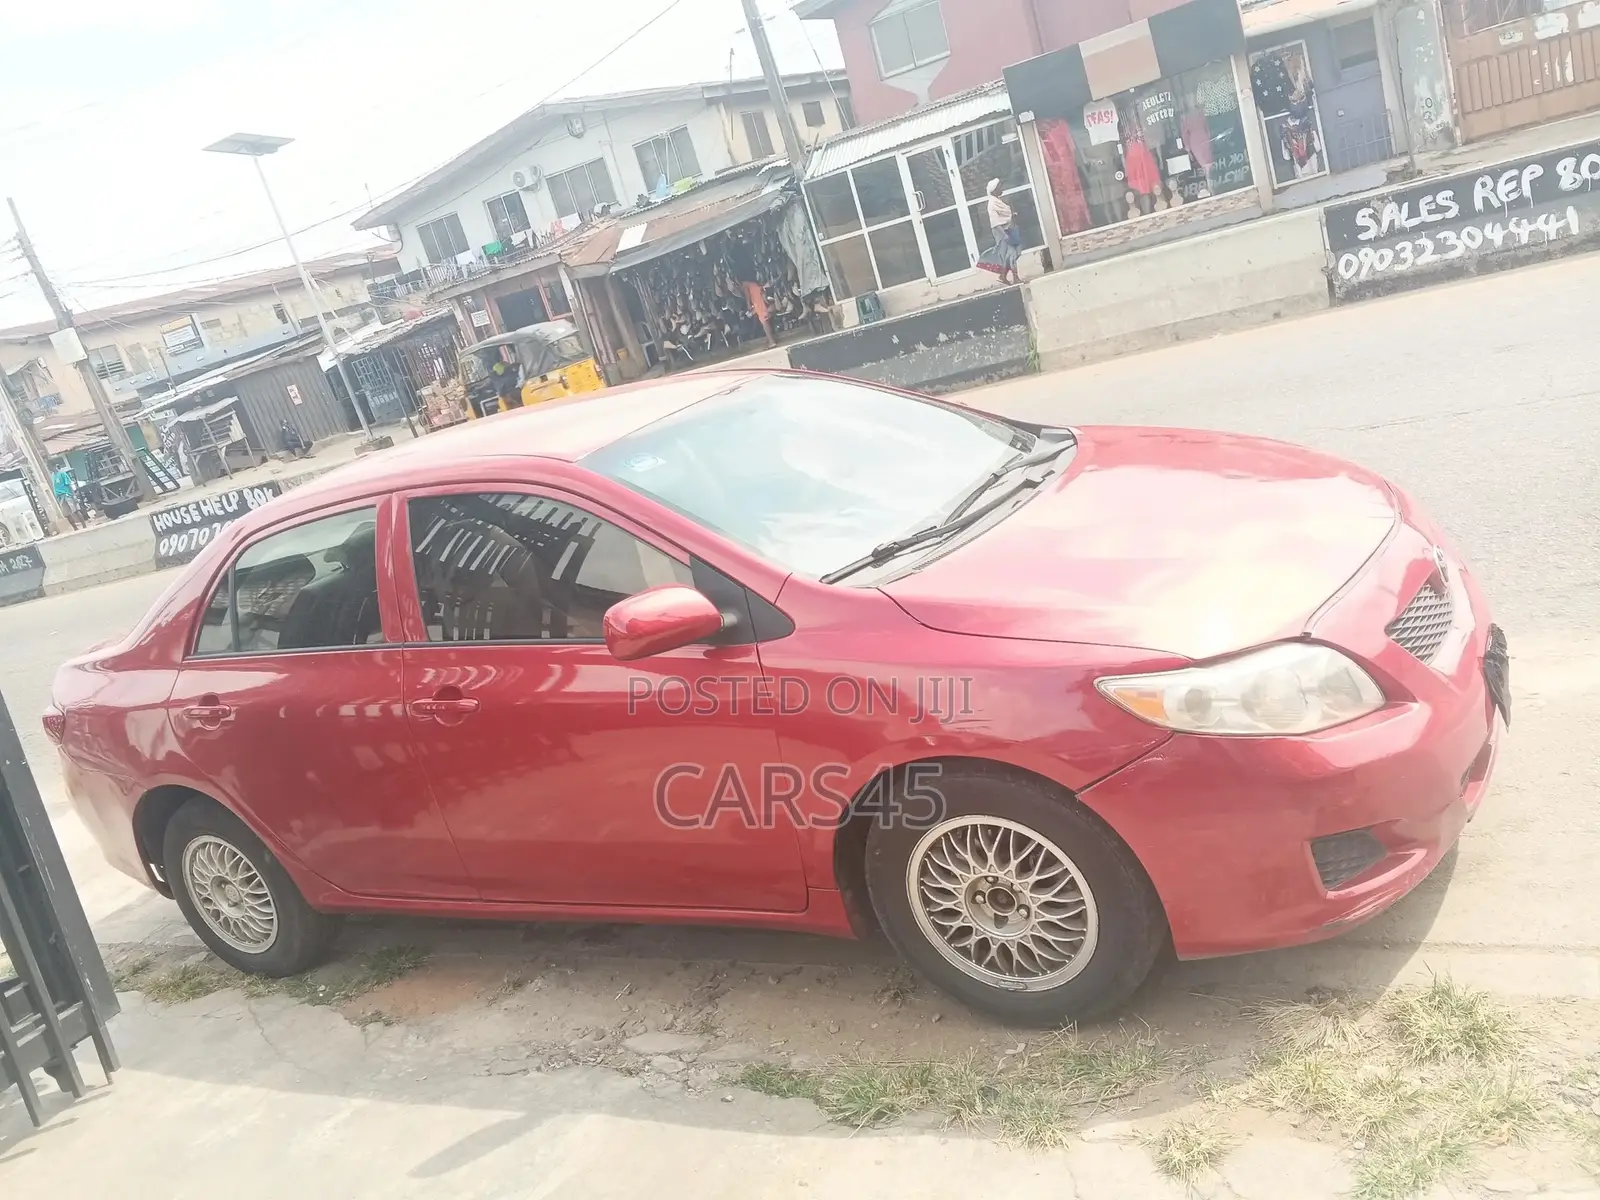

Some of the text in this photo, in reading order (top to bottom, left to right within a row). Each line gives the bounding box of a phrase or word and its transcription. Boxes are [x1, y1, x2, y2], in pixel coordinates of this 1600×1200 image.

[1356, 190, 1460, 241] SALES
[1474, 164, 1544, 214] REP
[1337, 205, 1580, 280] 09032304441
[153, 503, 202, 533] HOUSE
[199, 491, 239, 517] HELP
